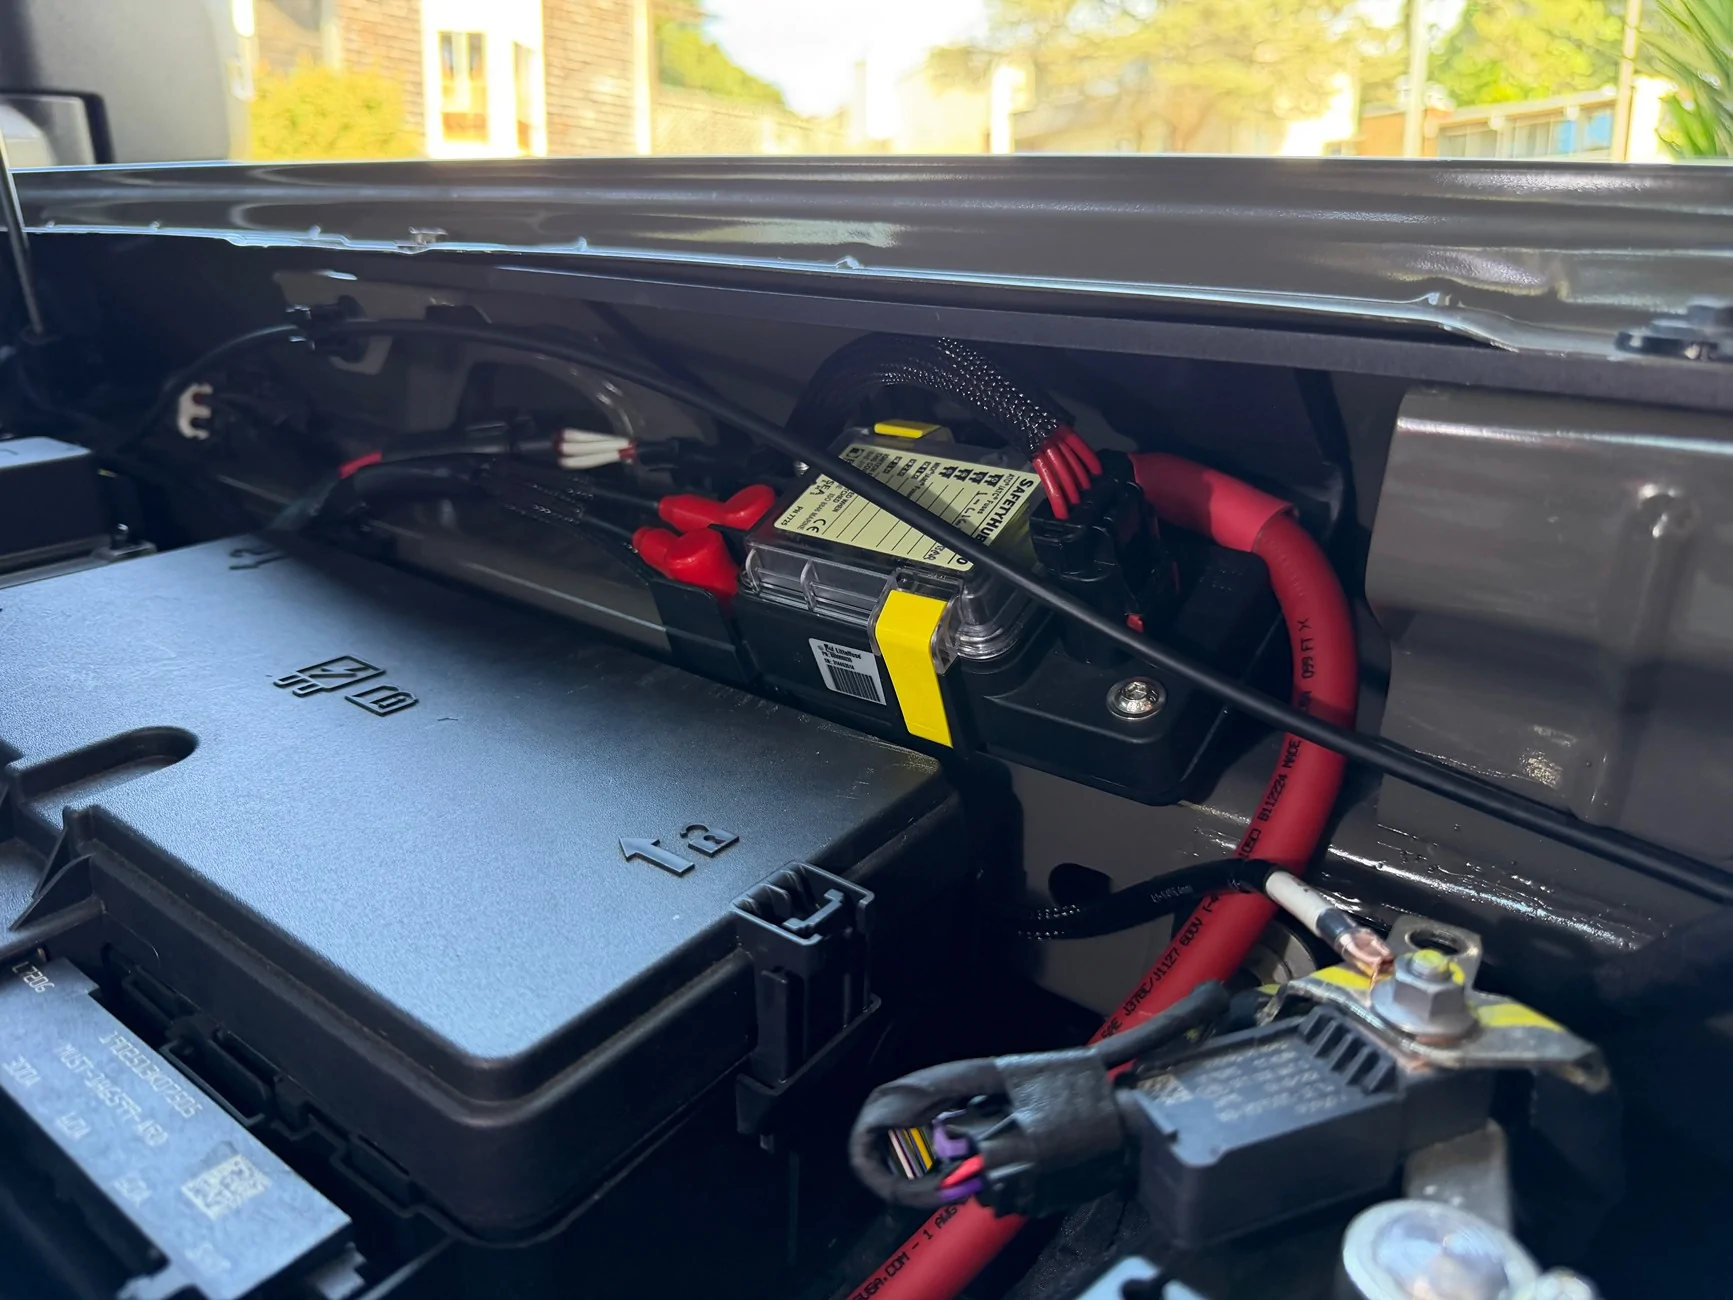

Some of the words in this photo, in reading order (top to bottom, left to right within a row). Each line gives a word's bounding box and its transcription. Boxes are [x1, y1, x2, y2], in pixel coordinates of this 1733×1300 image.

[973, 477, 1034, 542] SAFETYHUB
[976, 499, 994, 515] Fuses
[780, 513, 796, 526] 7725
[1300, 637, 1313, 652] FT
[1281, 738, 1302, 768] MADE
